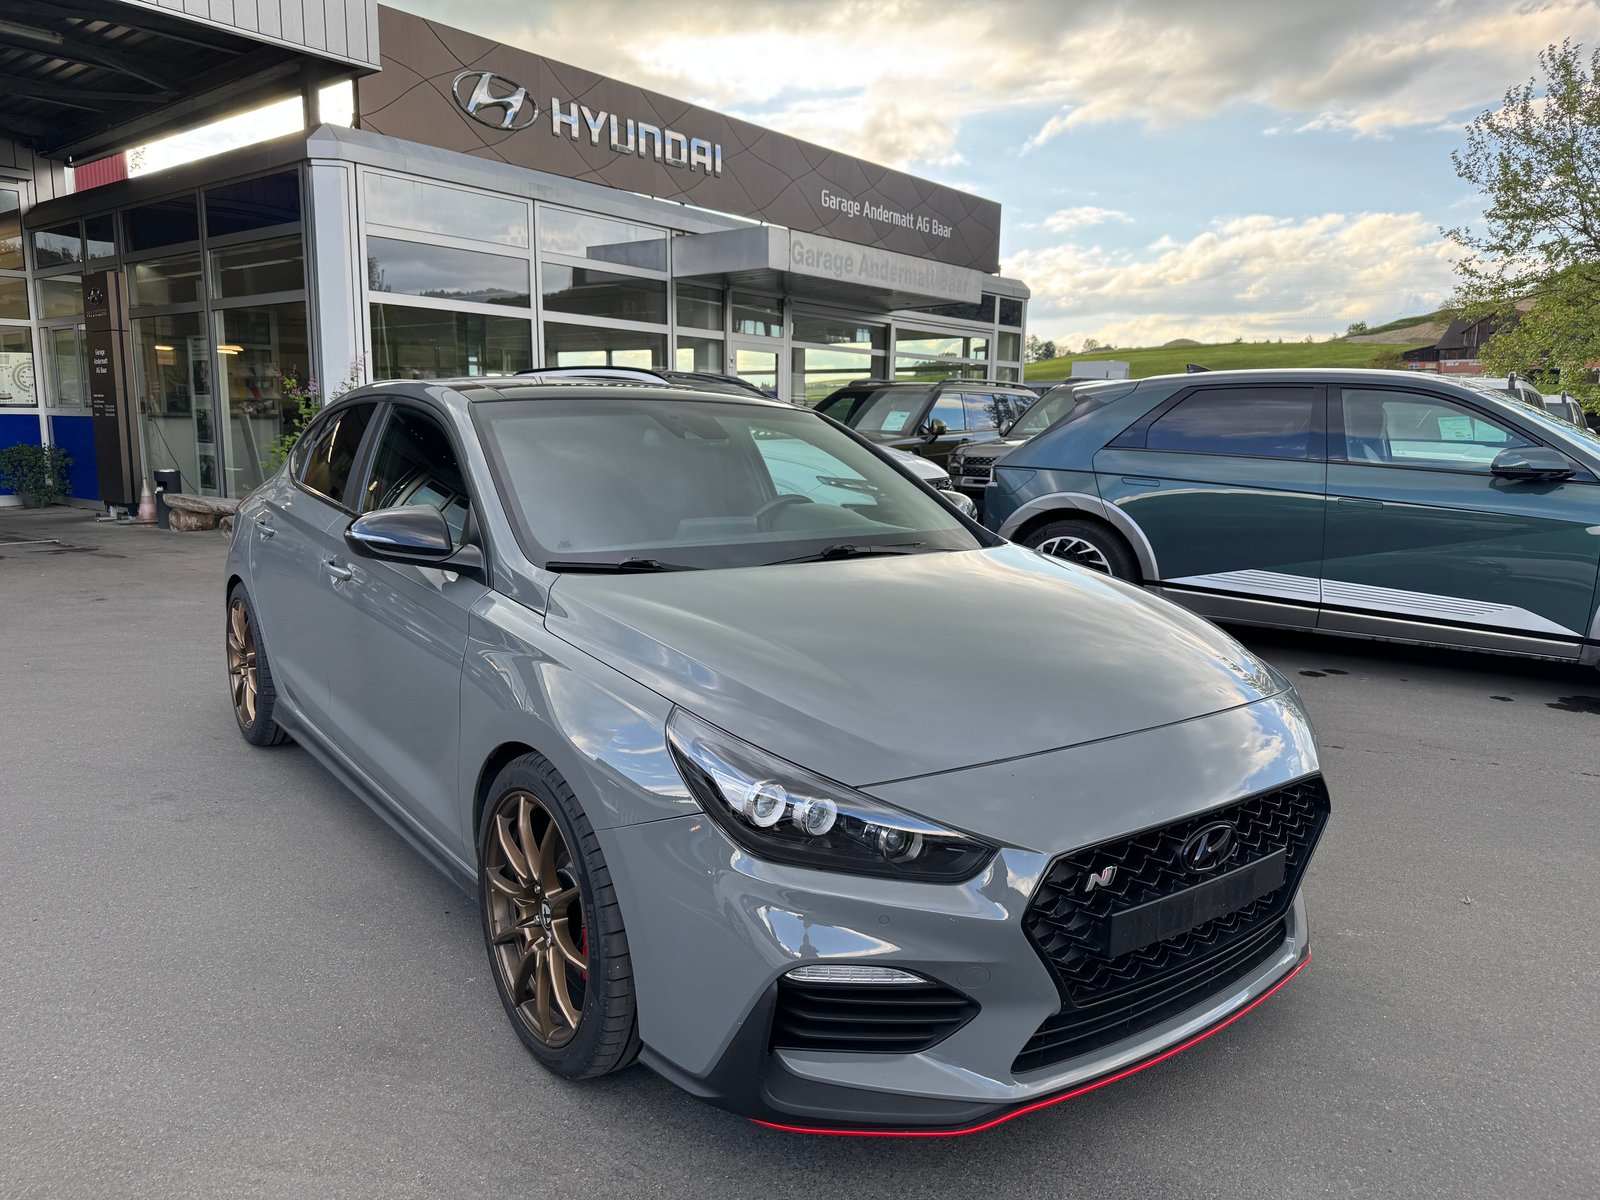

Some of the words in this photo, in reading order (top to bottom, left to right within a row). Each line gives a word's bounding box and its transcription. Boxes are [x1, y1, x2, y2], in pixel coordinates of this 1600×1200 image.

[551, 97, 722, 177] HYUNDAI
[821, 189, 860, 217] Garage
[863, 201, 914, 229] Andermatt
[916, 216, 930, 233] AG
[932, 220, 952, 238] Baar
[791, 239, 854, 276] Garage
